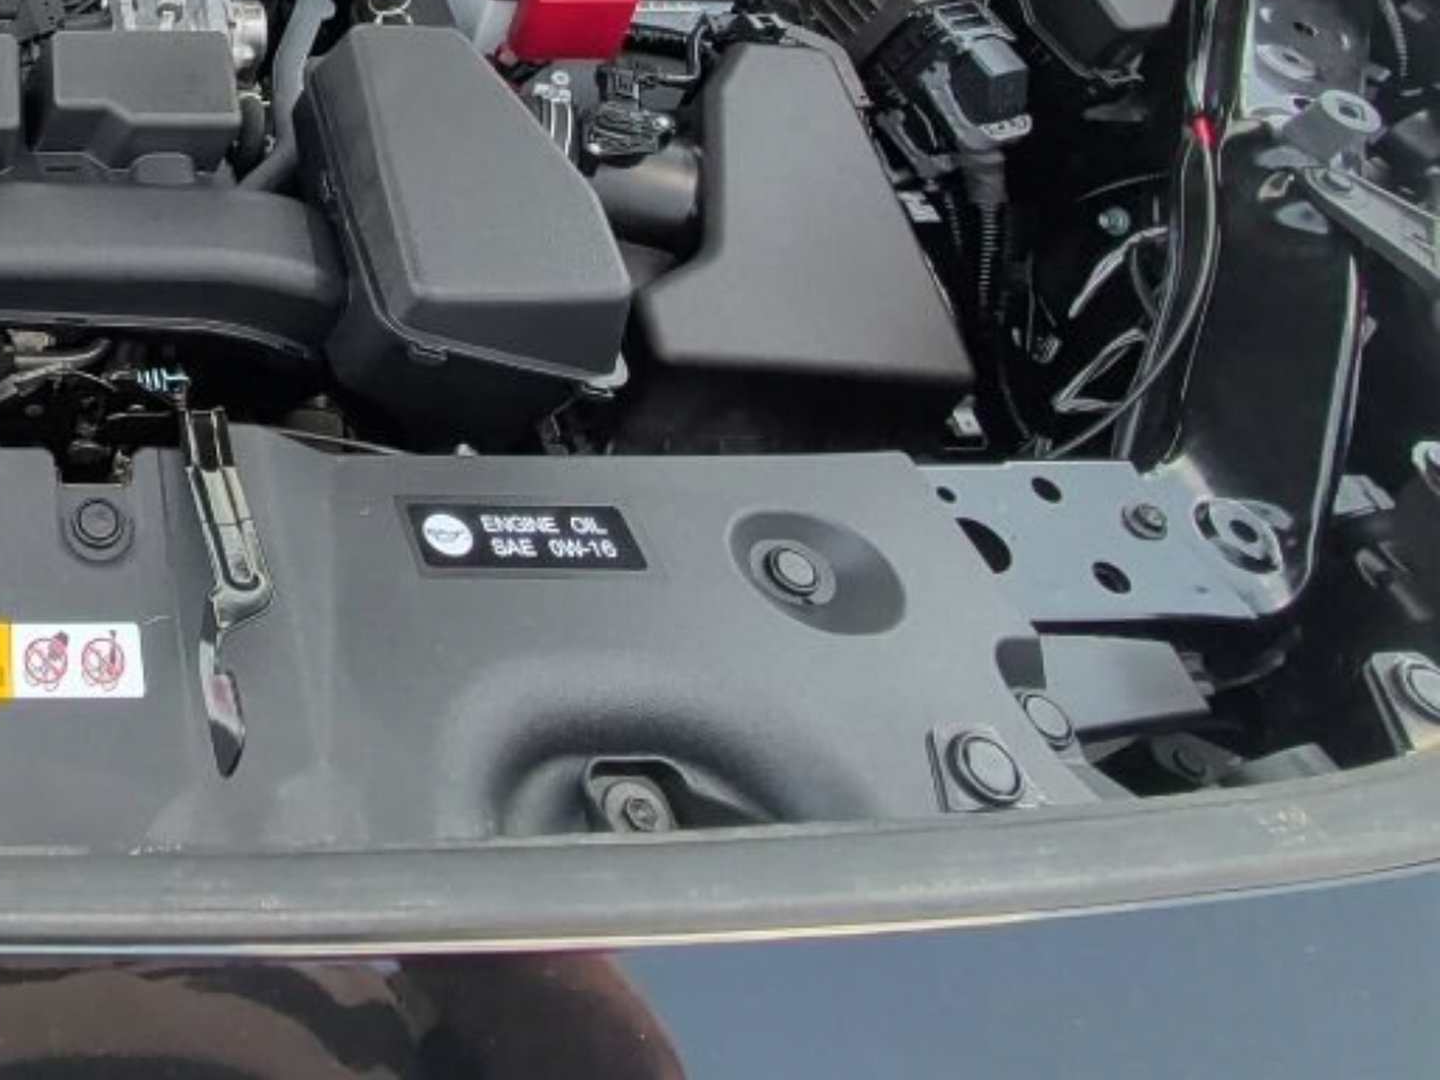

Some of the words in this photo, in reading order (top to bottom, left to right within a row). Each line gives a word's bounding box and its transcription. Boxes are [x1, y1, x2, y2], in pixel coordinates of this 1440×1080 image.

[480, 514, 560, 534] ENGINE
[570, 516, 609, 536] OIL
[491, 537, 539, 558] SAE
[548, 538, 619, 558] 0W-16
